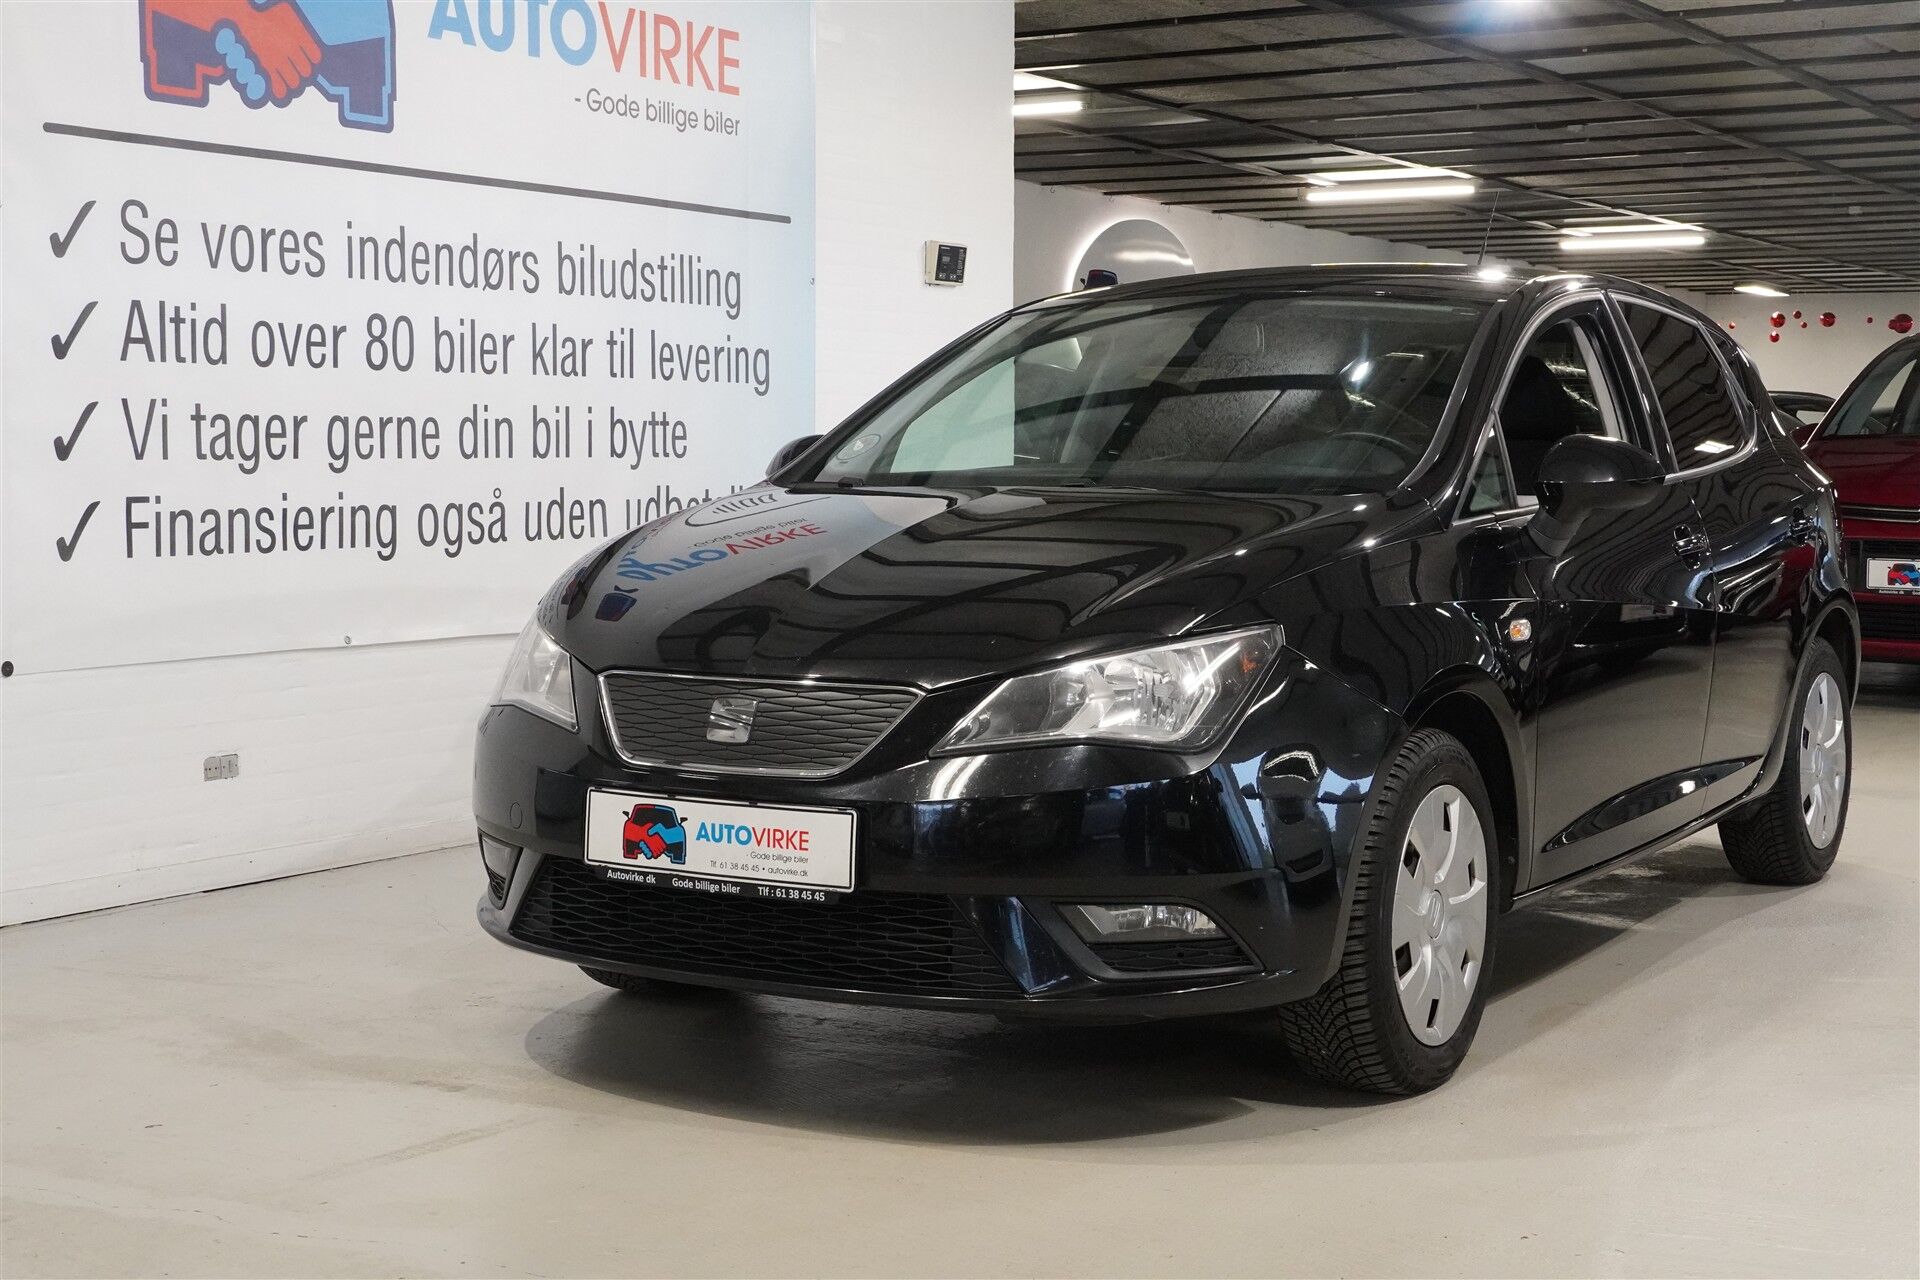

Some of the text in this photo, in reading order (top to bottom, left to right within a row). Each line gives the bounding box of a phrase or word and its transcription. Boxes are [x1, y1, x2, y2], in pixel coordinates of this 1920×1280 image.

[428, 0, 740, 96] AUTOVIRKE
[587, 88, 640, 119] Gode
[646, 98, 699, 133] billige
[704, 109, 740, 136] biler
[120, 199, 741, 320] Se vores indendørs biludstilling
[119, 300, 770, 397] Altid over 80 biler klar til levering
[120, 398, 688, 475] Vi tager gerne din bil i bytte
[125, 492, 398, 562] Finansiering
[417, 487, 508, 559] også
[524, 487, 608, 542] uden
[695, 821, 809, 851] AUTOVIRKE
[607, 870, 656, 884] Autovirke dk
[719, 861, 727, 869] 61
[730, 862, 738, 870] 38
[740, 863, 749, 871] 45
[751, 865, 759, 873] 45
[750, 851, 771, 861] Gode
[772, 854, 792, 864] billige
[794, 856, 808, 864] biler
[672, 878, 740, 894] Gode billige biler
[758, 886, 769, 896] Tlf
[776, 889, 786, 898] 61
[789, 889, 799, 899] 38
[801, 891, 812, 900] 45
[814, 892, 825, 901] 45
